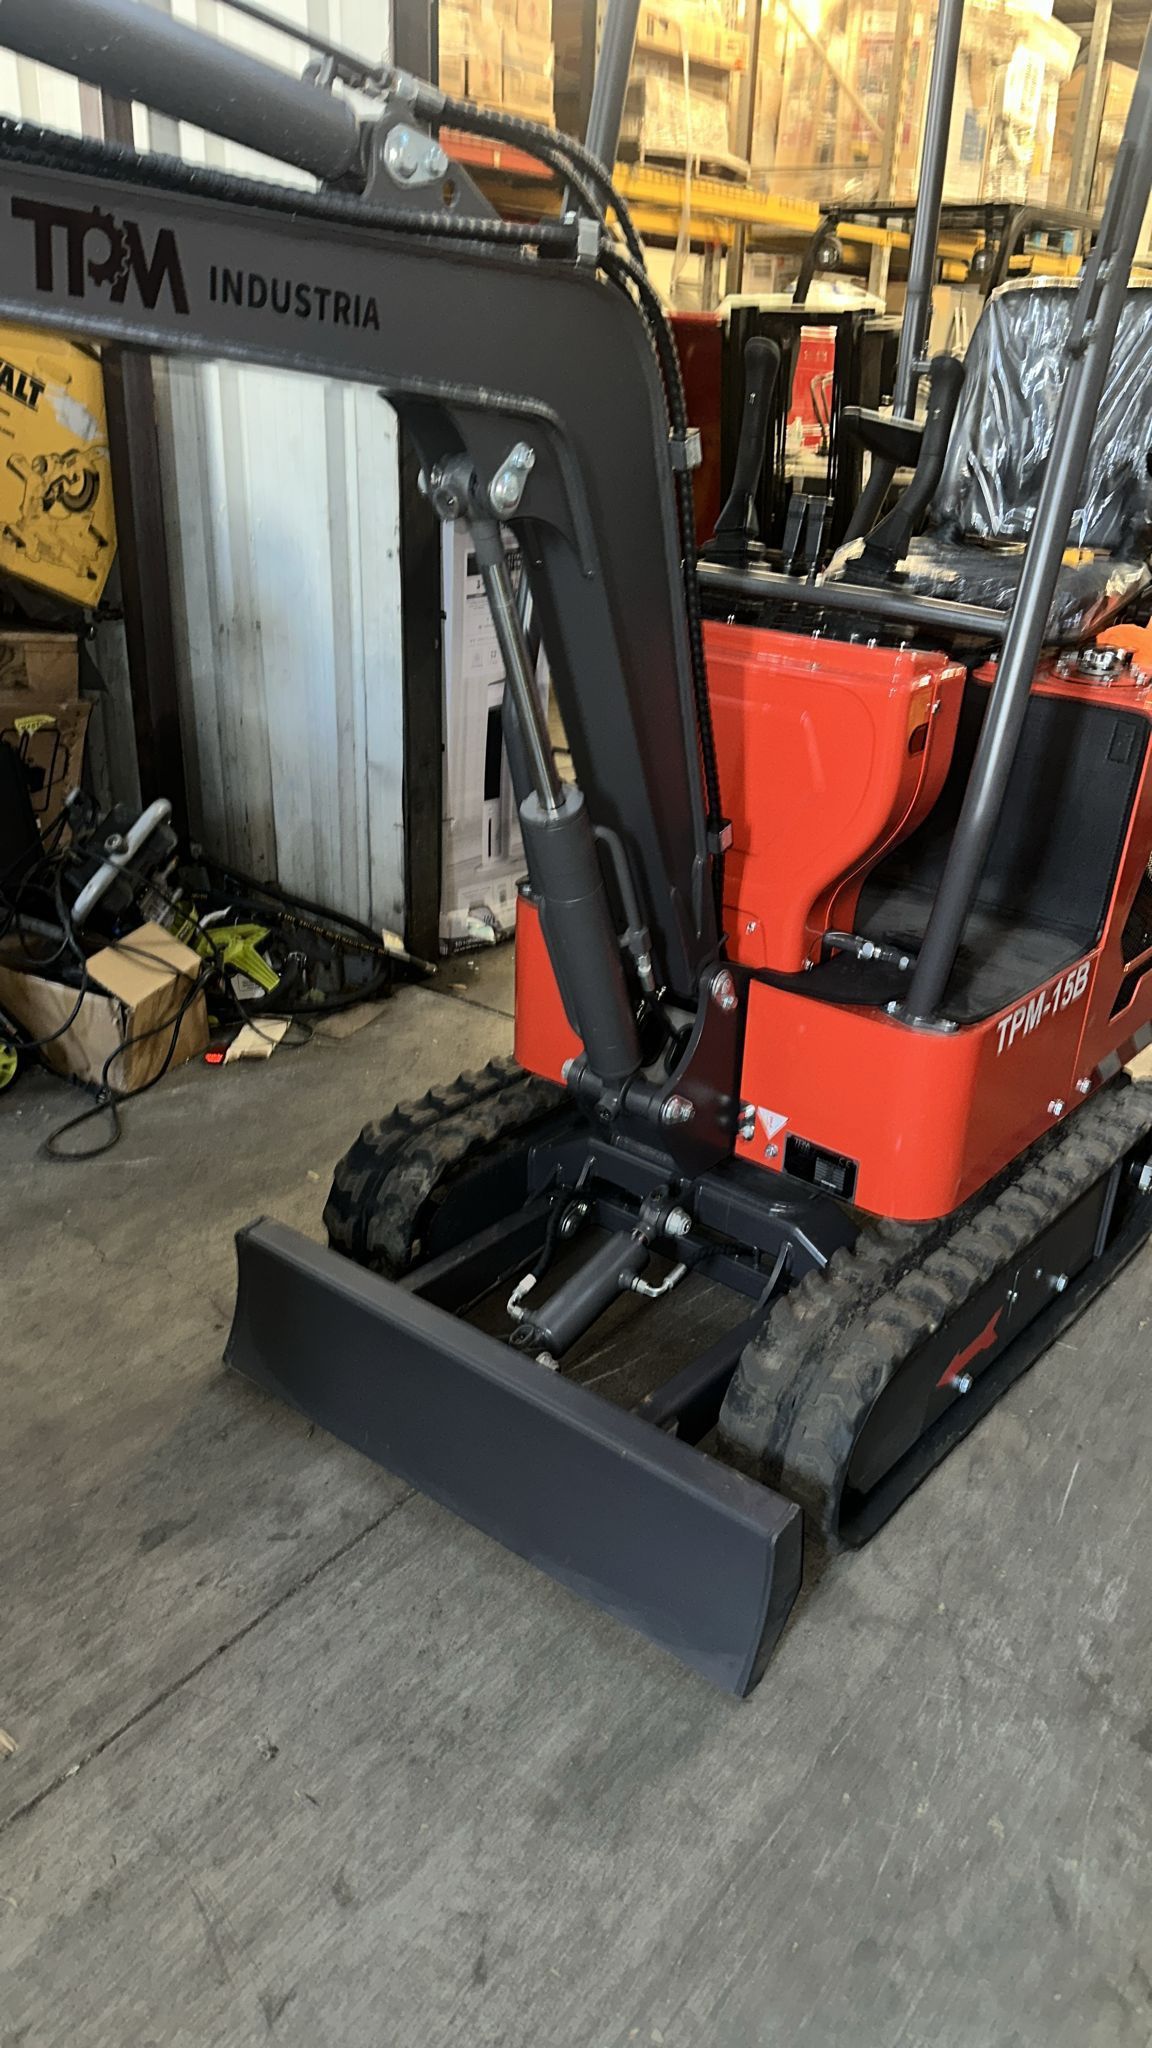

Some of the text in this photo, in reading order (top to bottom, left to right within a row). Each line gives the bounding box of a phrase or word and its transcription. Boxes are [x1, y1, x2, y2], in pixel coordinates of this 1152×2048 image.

[11, 196, 380, 331] TPM INDUSTRIA
[0, 360, 45, 411] ALT
[996, 960, 1091, 1057] TPM-15B
